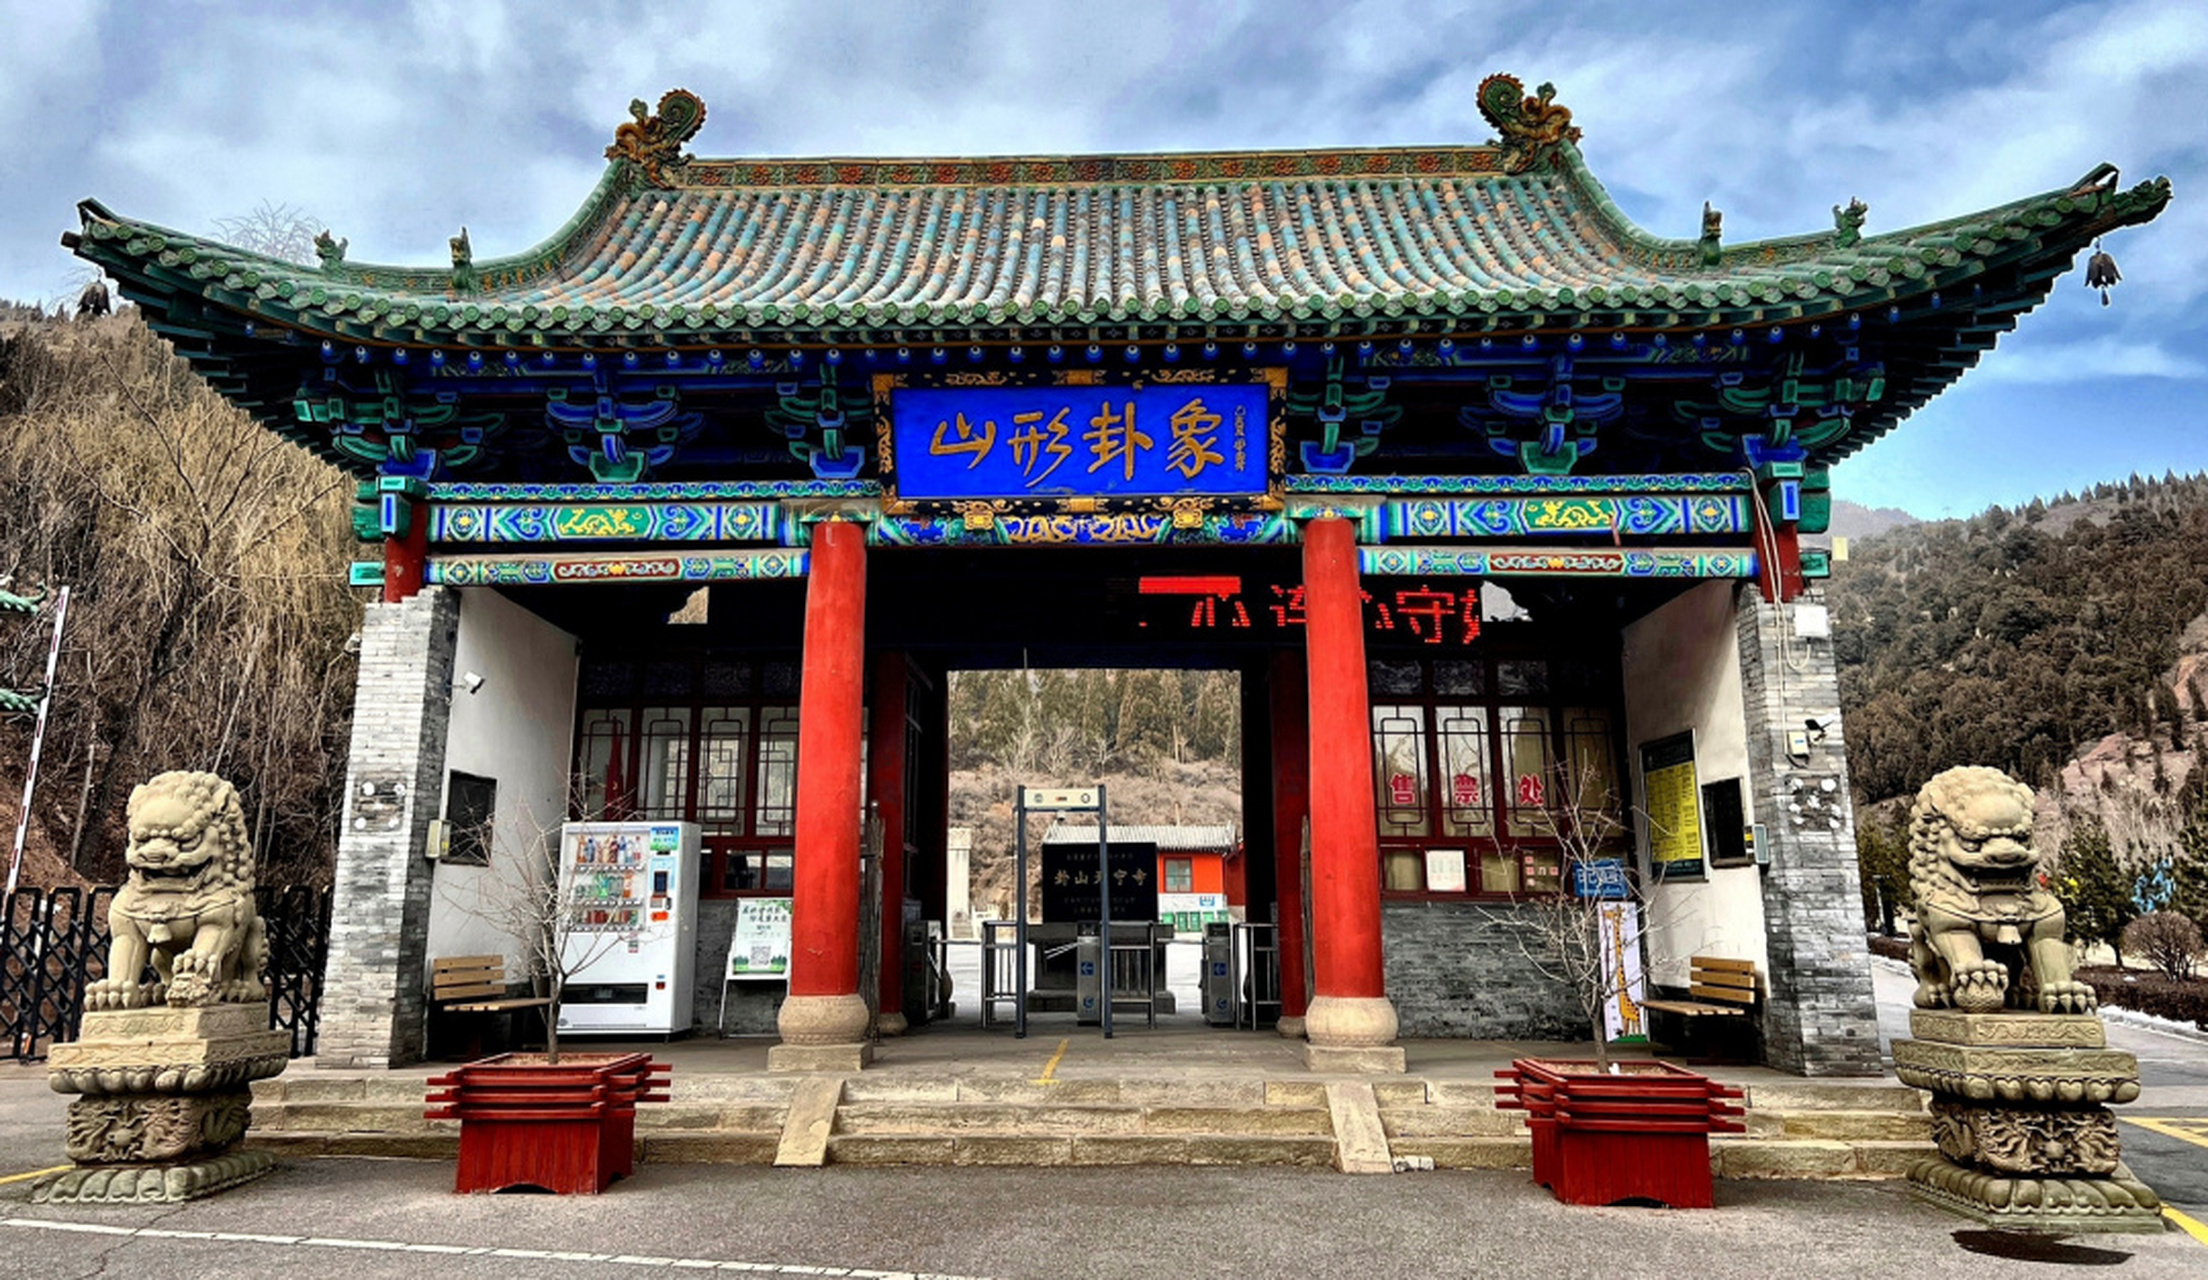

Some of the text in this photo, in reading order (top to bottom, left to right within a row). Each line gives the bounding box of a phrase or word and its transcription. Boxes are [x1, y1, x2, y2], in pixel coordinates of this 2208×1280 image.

[929, 399, 1225, 488] 山形卦象
[1391, 772, 1545, 806] 售票处
